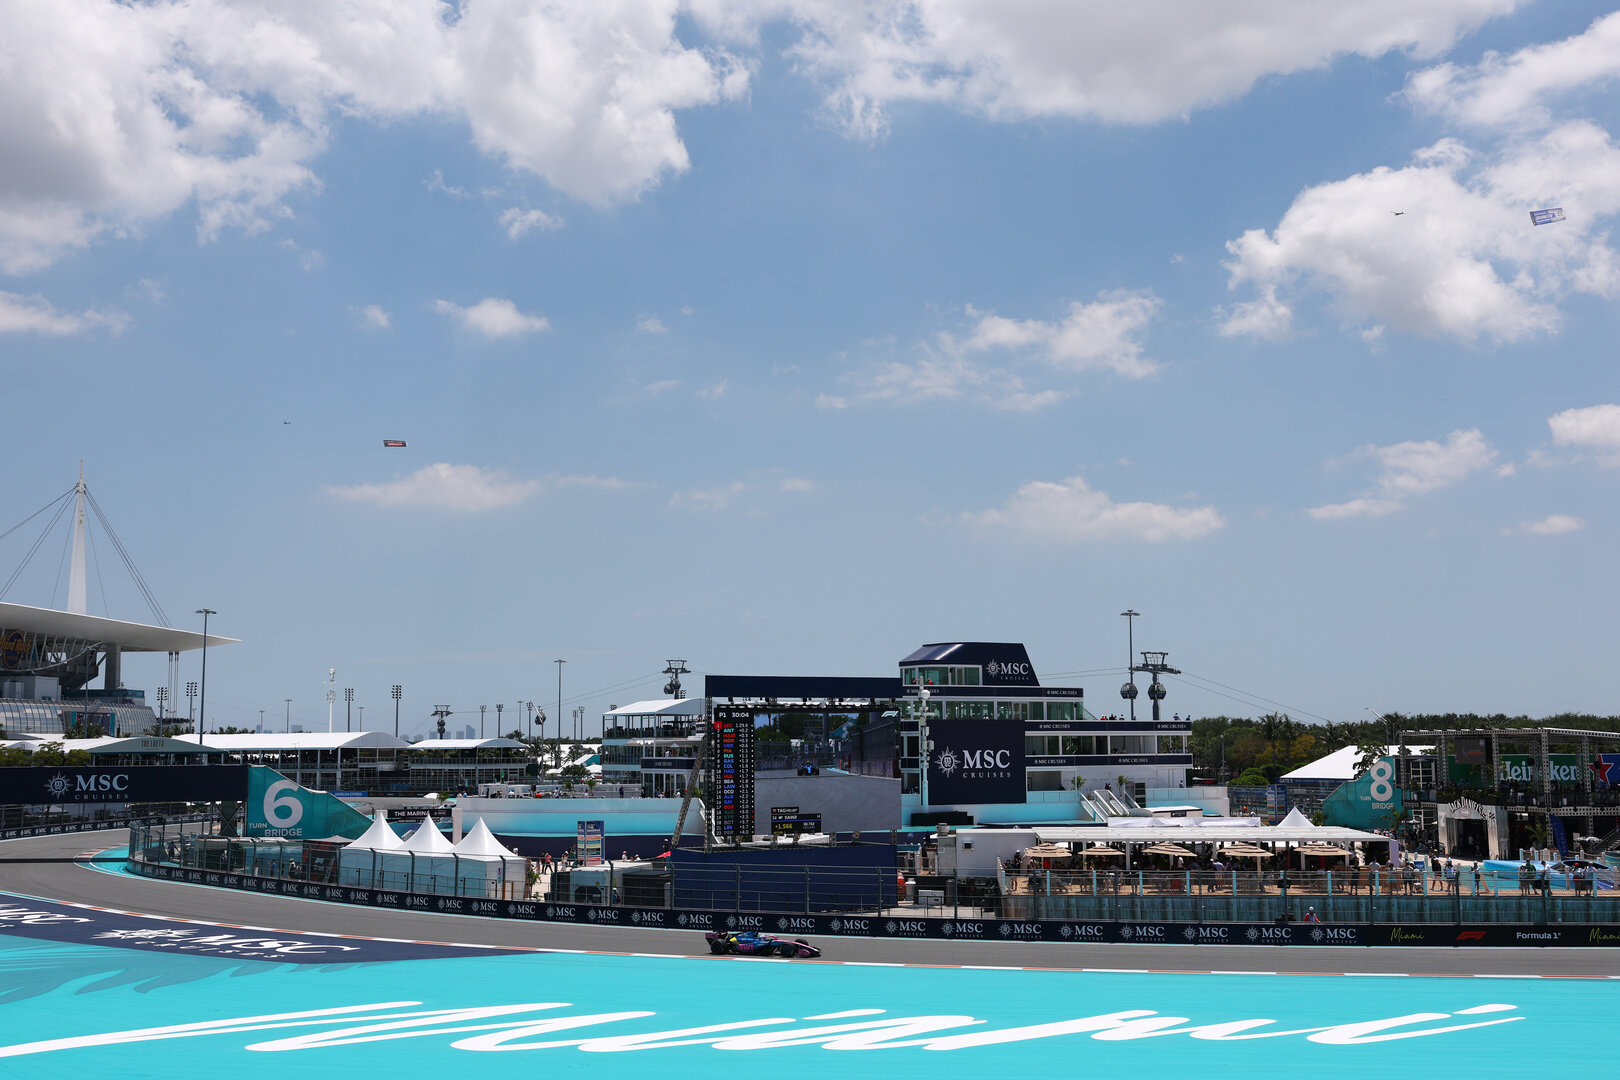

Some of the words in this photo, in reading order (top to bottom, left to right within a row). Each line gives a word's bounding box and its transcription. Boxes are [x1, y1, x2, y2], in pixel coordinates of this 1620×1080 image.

[1000, 663, 1028, 674] MSC
[962, 750, 1010, 768] MSC
[75, 774, 129, 791] MSC
[1370, 761, 1392, 801] 8
[264, 780, 303, 828] 6
[265, 828, 302, 836] BRIDGE
[287, 884, 298, 892] MSC
[309, 886, 320, 895] MSC
[331, 888, 343, 898] MSC
[356, 892, 369, 900] MSC
[383, 894, 398, 903] MSC
[413, 897, 429, 906] MSC
[446, 899, 462, 908] MSC
[480, 902, 498, 911] MSC
[517, 905, 536, 914] MSC
[556, 907, 576, 917] MSC
[598, 910, 619, 919] MSC
[642, 912, 664, 922] MSC
[690, 914, 712, 924] MSC
[739, 917, 763, 926] MSC
[791, 918, 815, 928] MSC
[844, 920, 869, 929] MSC
[900, 922, 926, 931] MSC
[956, 923, 983, 933] MSC
[1014, 924, 1042, 934] MSC
[1075, 926, 1103, 936] MSC
[1136, 926, 1164, 936] MSC
[1199, 927, 1228, 937] MSC
[1262, 928, 1292, 938] MSC
[1326, 928, 1356, 939] MSC
[1390, 927, 1425, 942] Miami
[169, 934, 360, 954] MSC
